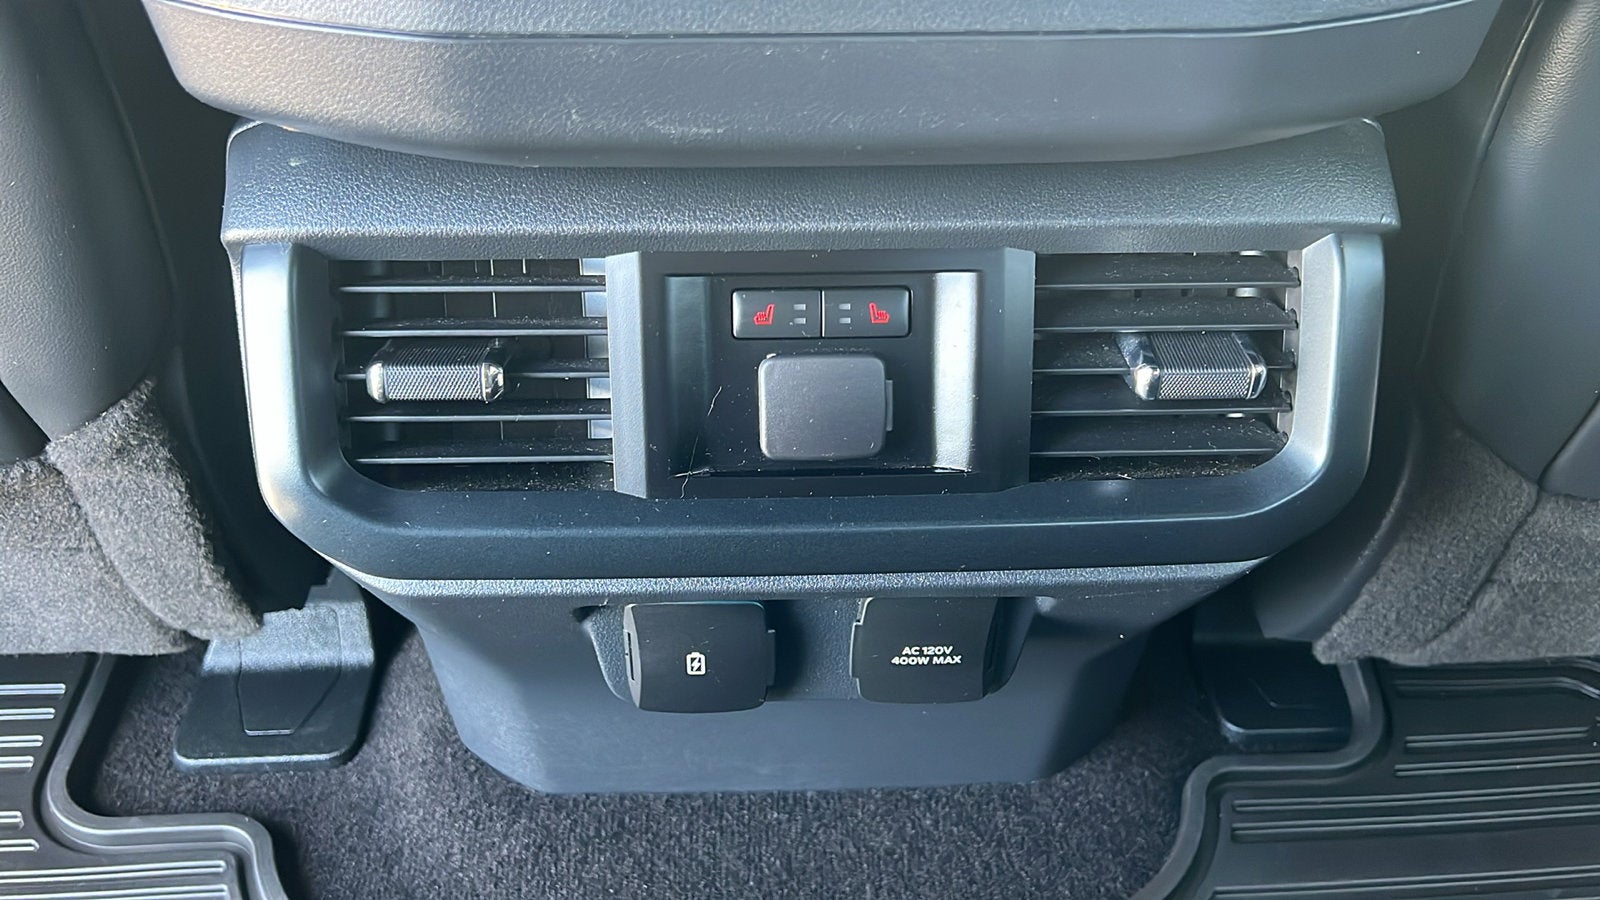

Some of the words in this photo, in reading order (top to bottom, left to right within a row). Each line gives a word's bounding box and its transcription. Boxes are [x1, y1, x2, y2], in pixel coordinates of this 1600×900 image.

[902, 646, 920, 655] AC
[921, 646, 953, 655] 120V
[891, 656, 929, 665] 400W
[932, 655, 961, 664] MAX
